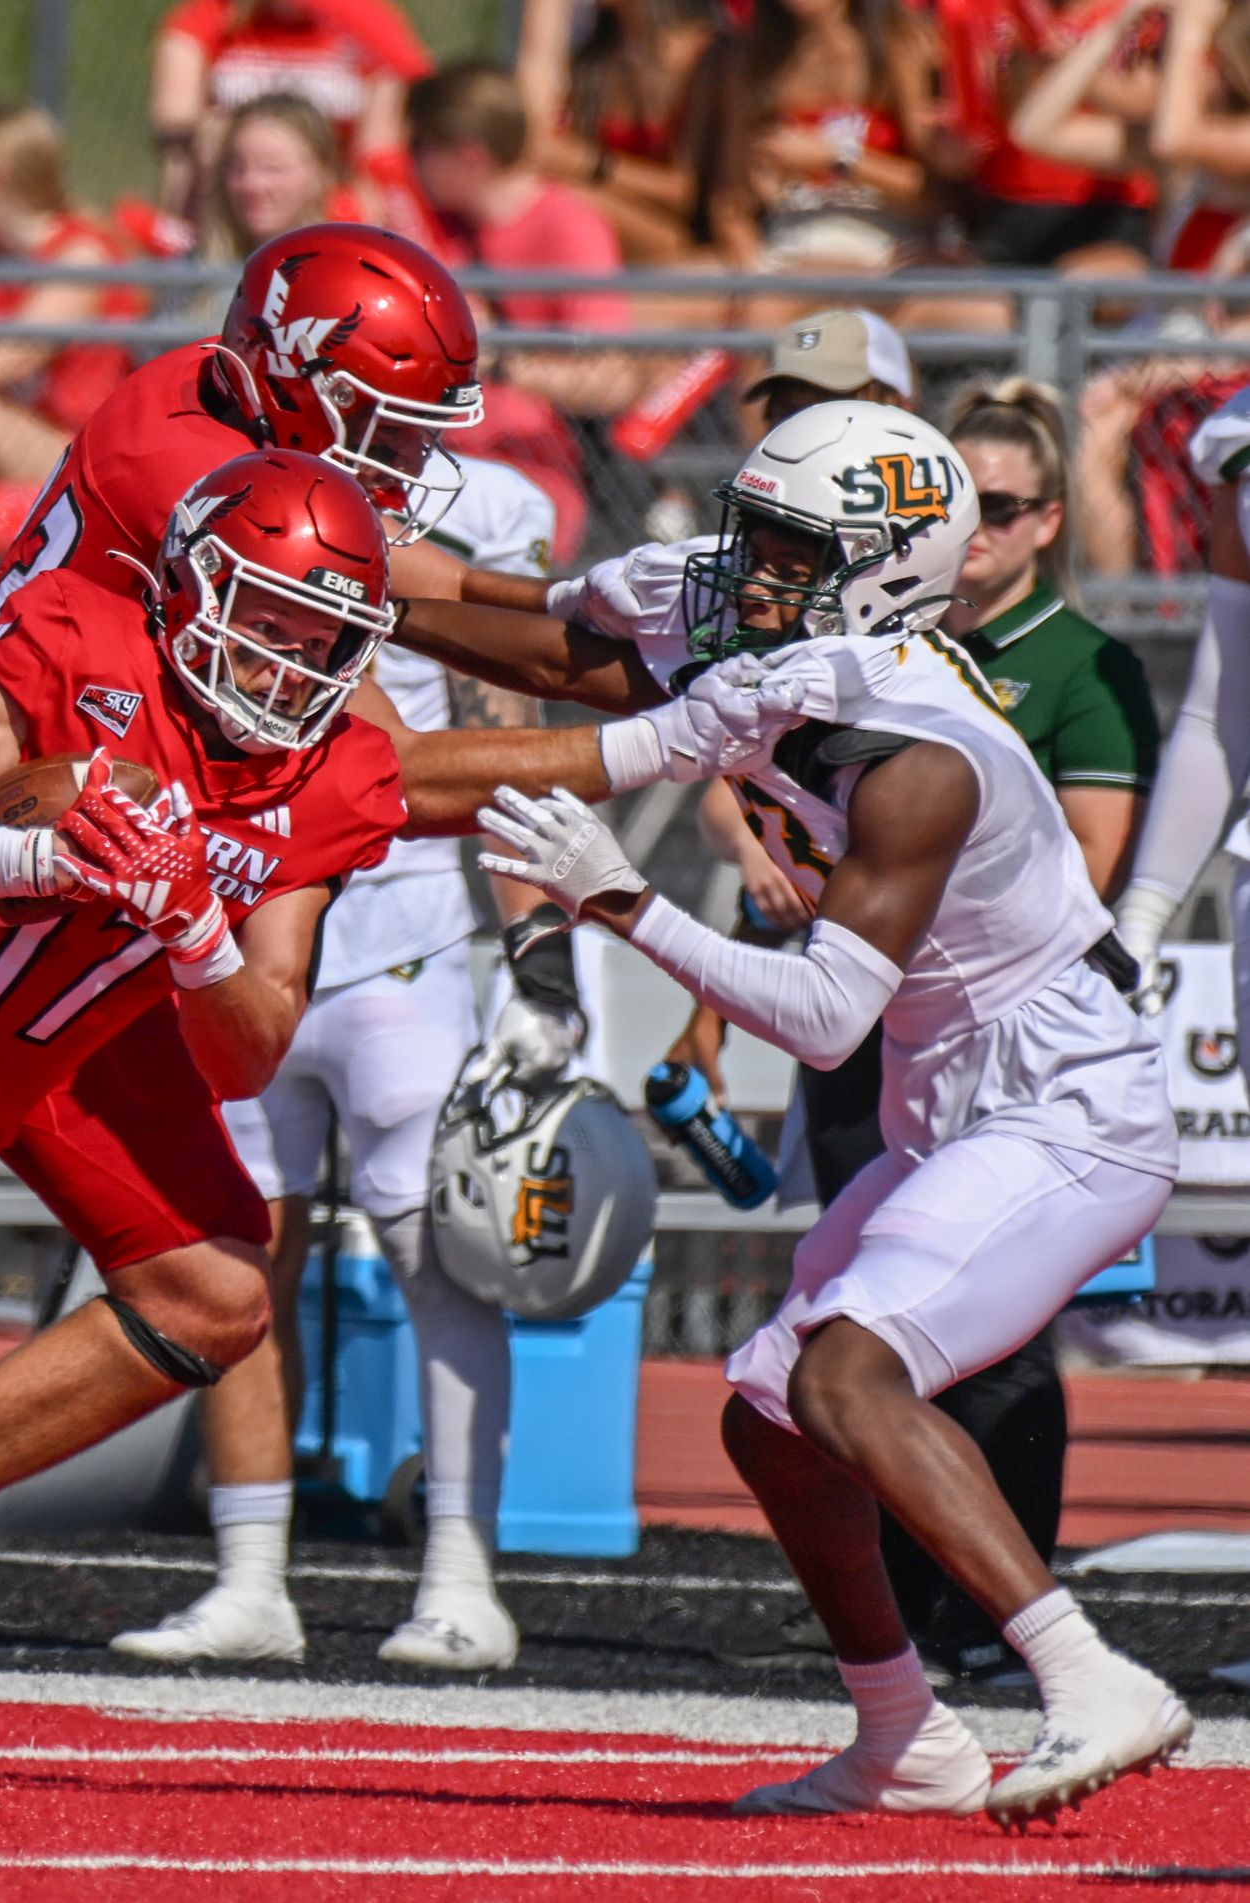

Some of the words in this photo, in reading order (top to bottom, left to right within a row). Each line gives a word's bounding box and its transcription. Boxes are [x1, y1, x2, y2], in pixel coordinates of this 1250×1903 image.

[739, 470, 777, 494] Riddell
[842, 454, 953, 515] SLU
[321, 569, 365, 600] EKG
[104, 693, 136, 717] SKY
[511, 1141, 572, 1267] SLU
